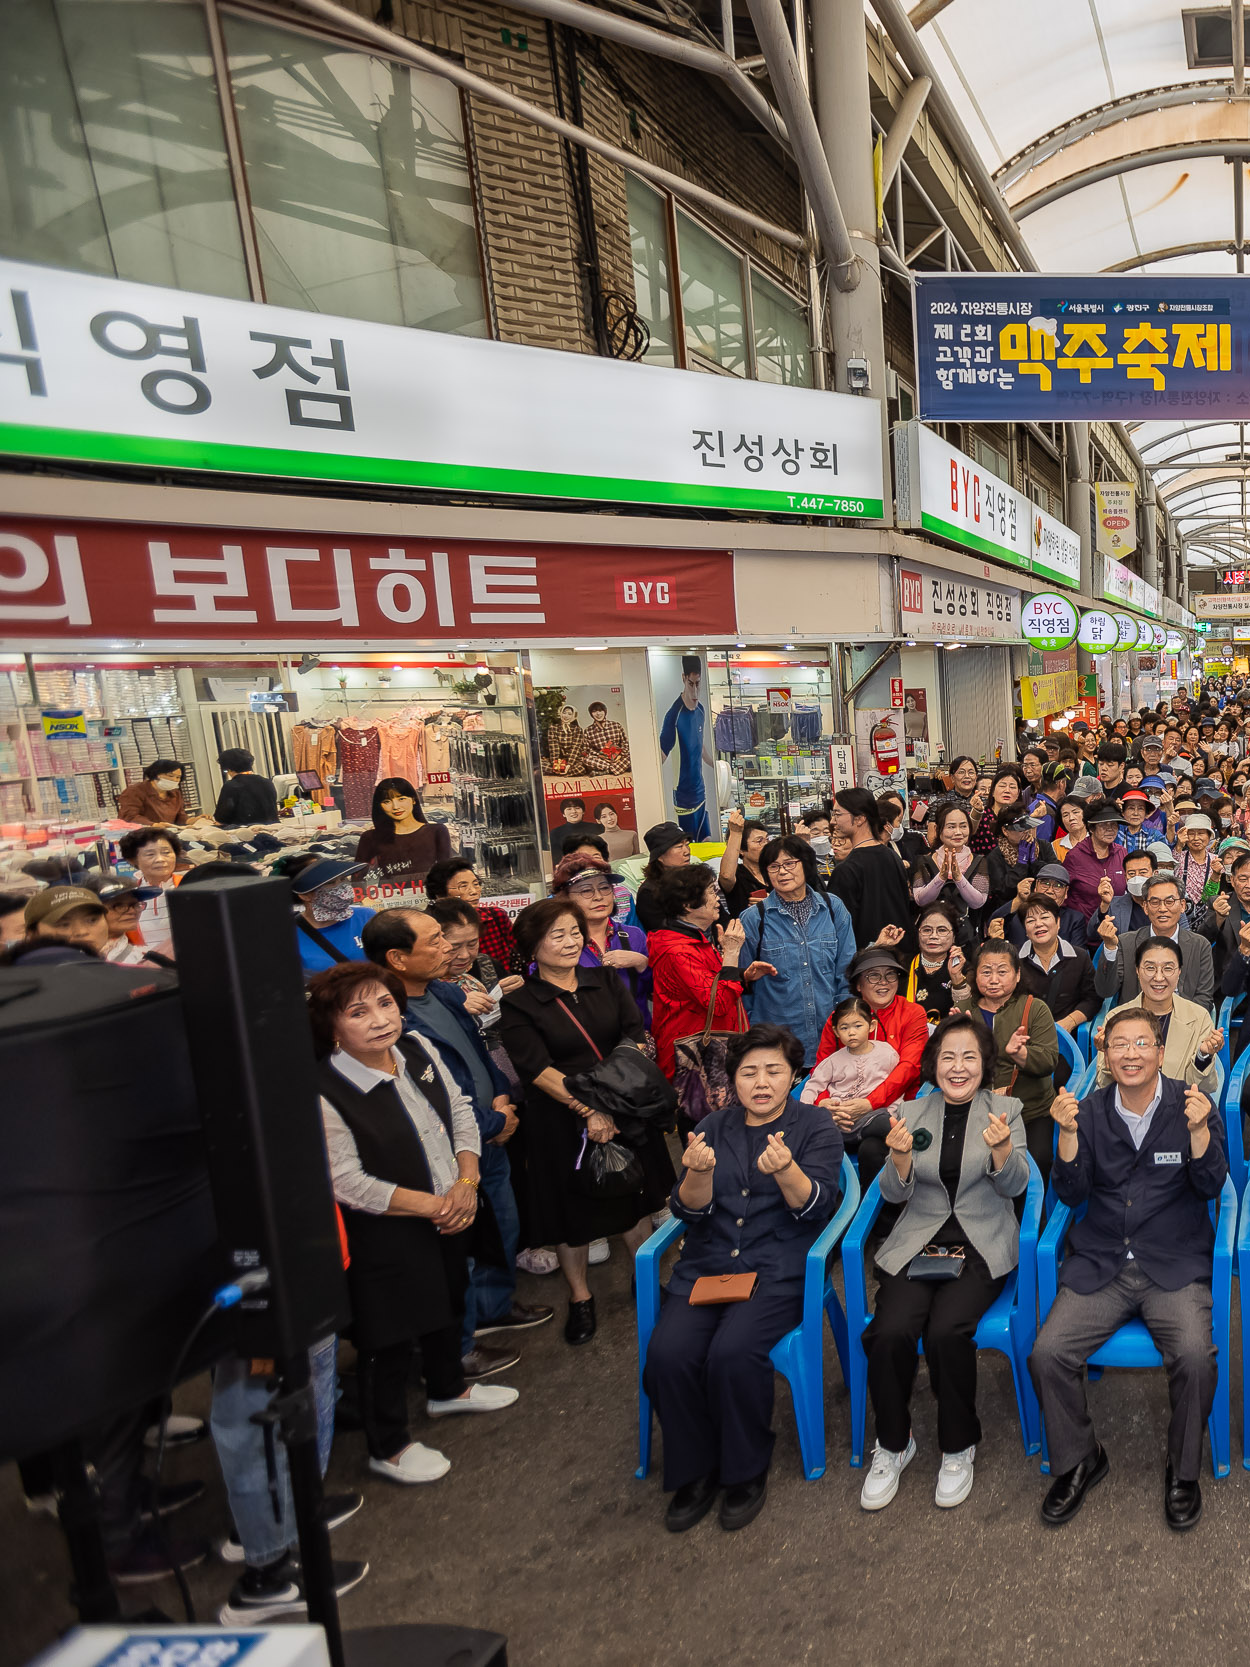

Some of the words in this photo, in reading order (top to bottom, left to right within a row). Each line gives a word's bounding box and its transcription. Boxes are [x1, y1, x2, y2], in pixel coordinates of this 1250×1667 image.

[930, 302, 958, 315] 2024
[960, 302, 1033, 316] 자양전통시장
[1068, 304, 1104, 313] 서울특별시
[934, 324, 953, 341] 제
[936, 346, 994, 368] 고객과
[999, 322, 1114, 391] 맥주
[1117, 322, 1231, 391] 축제
[936, 368, 1015, 390] 함께하는
[691, 426, 841, 477] 진성상회
[786, 494, 865, 514] T.447-7850
[950, 458, 980, 523] BYC
[986, 484, 1016, 541] 직영점
[148, 541, 546, 630] 보디히트
[622, 581, 672, 606] BYC
[904, 578, 921, 609] BYC
[932, 580, 979, 618] 진성상회
[986, 592, 1012, 622] 직영점
[1034, 603, 1063, 614] BYC
[1028, 618, 1070, 634] 직영점
[1090, 617, 1106, 626] 하림
[1092, 627, 1104, 640] 닭
[430, 773, 448, 782] BYC
[544, 780, 586, 796] HOME
[590, 776, 634, 791] WEAR
[353, 881, 406, 903] BODY
